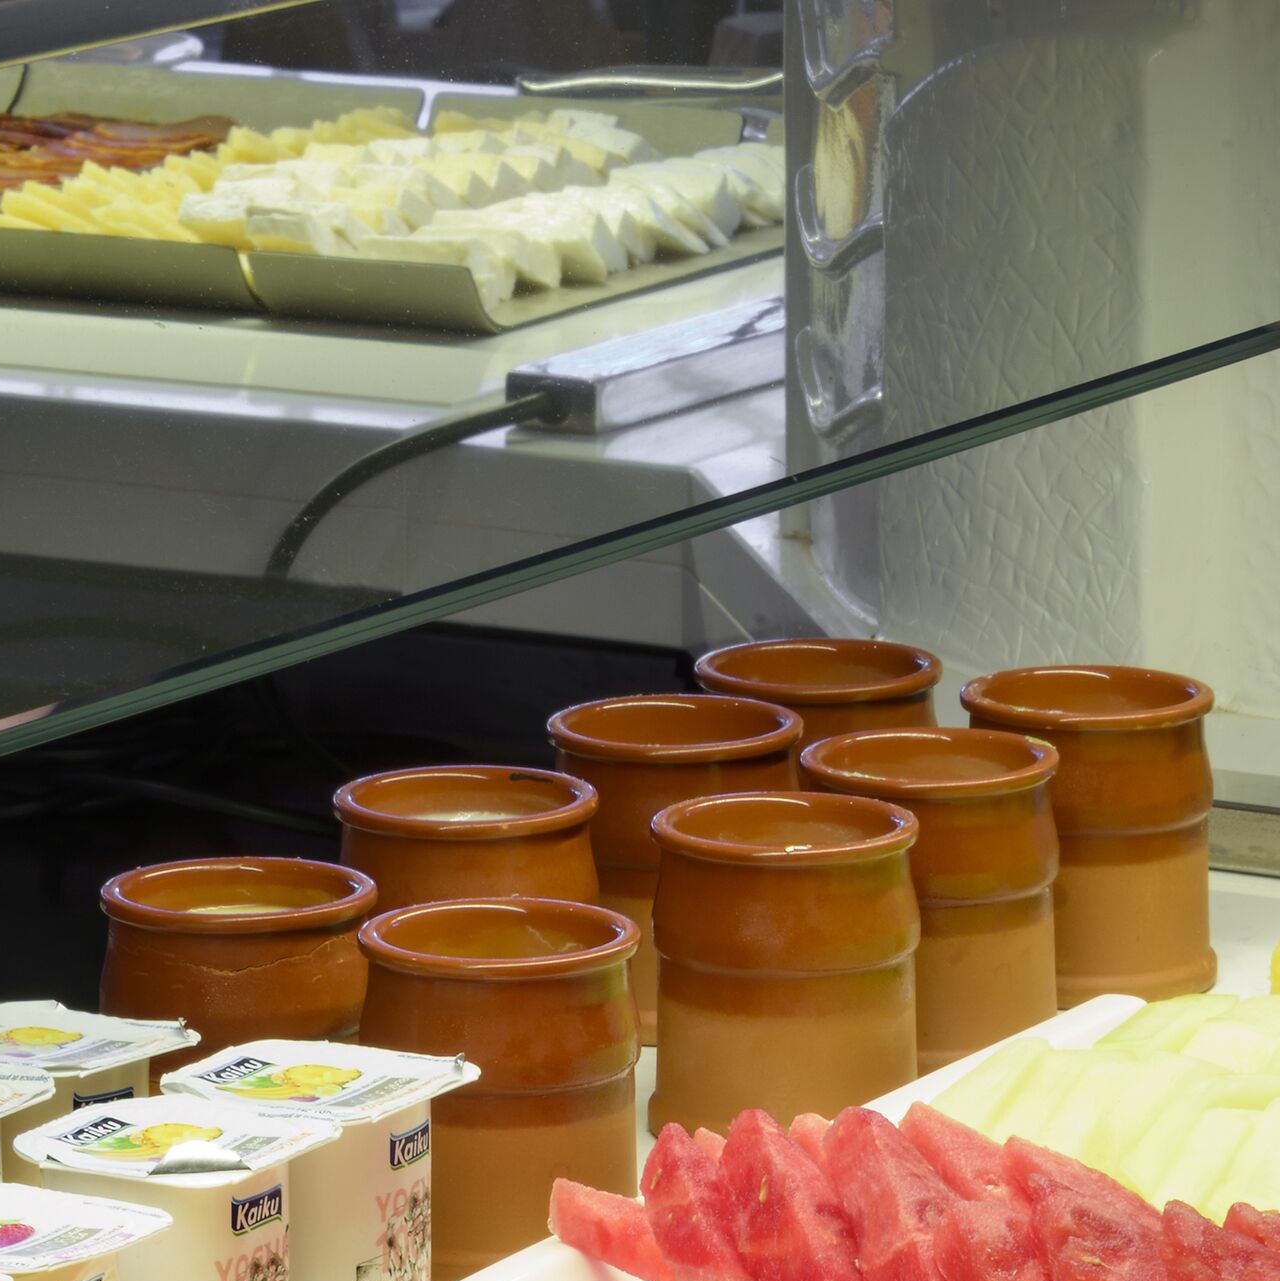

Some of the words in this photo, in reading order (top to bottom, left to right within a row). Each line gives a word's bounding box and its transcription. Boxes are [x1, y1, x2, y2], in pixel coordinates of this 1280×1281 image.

[204, 1058, 266, 1085] Kaiku
[61, 1118, 122, 1146] Kaiku
[394, 1131, 429, 1166] Kaiku
[236, 1195, 280, 1231] Kaiku
